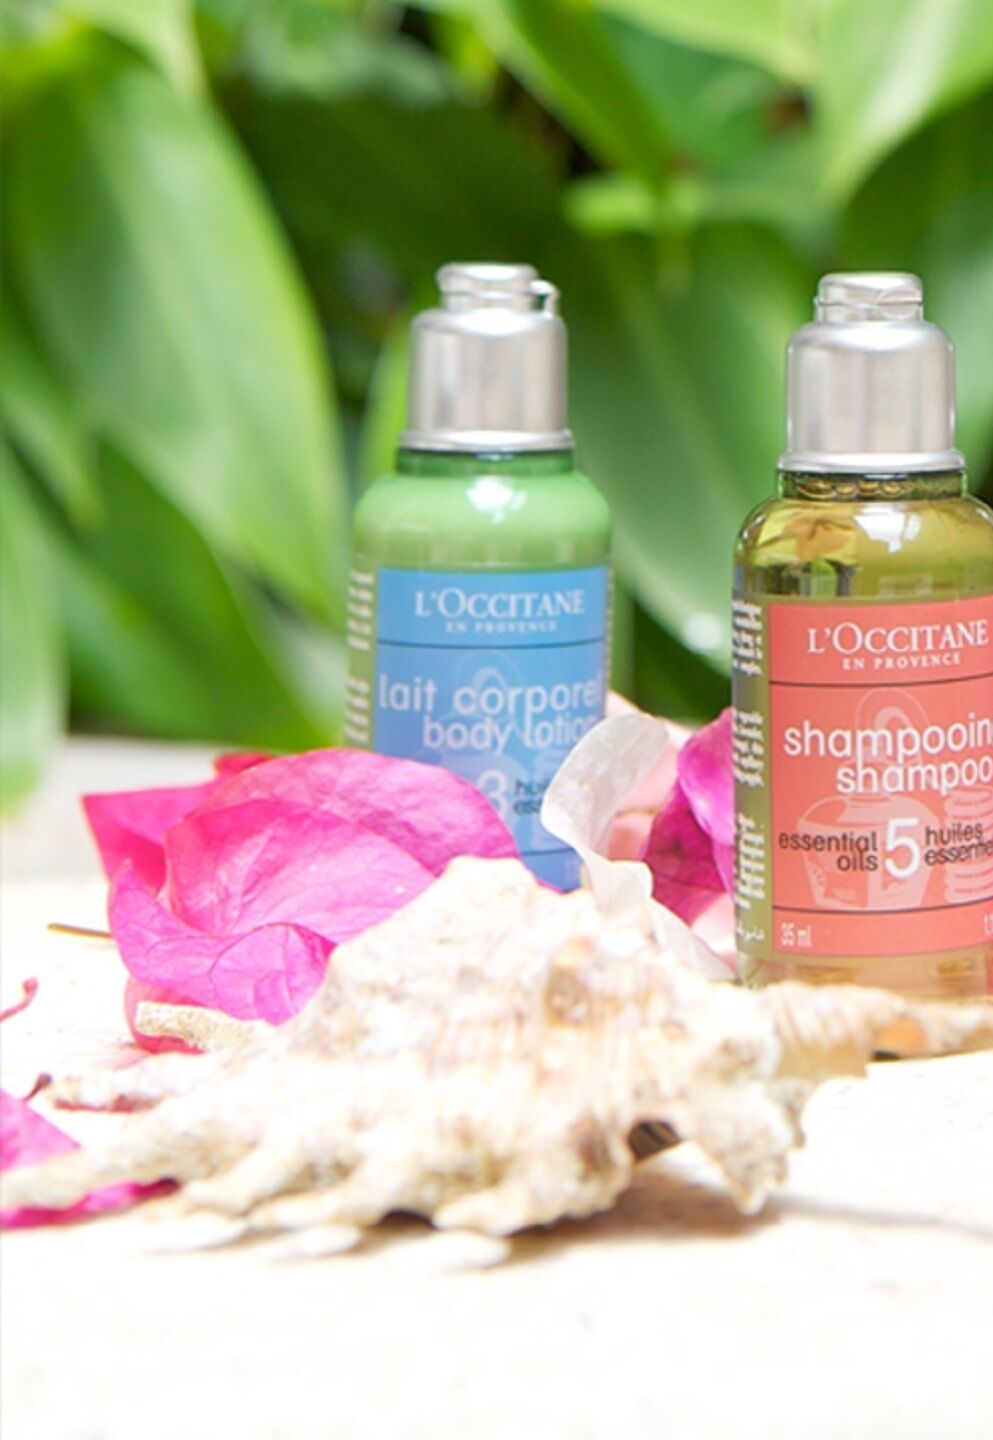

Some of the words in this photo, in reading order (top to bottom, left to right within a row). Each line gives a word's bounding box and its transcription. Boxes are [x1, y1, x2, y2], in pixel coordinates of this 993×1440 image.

[414, 586, 586, 617] L'OCCITANE
[807, 618, 989, 654] L'OCCITANE
[842, 658, 865, 670] EN
[873, 653, 961, 670] PROVENCE
[378, 673, 437, 713] lait
[422, 715, 514, 756] body
[836, 753, 993, 797] shampoo
[778, 830, 879, 853] essential
[884, 816, 922, 879] 5
[924, 821, 984, 846] huiles
[836, 850, 879, 872] oils
